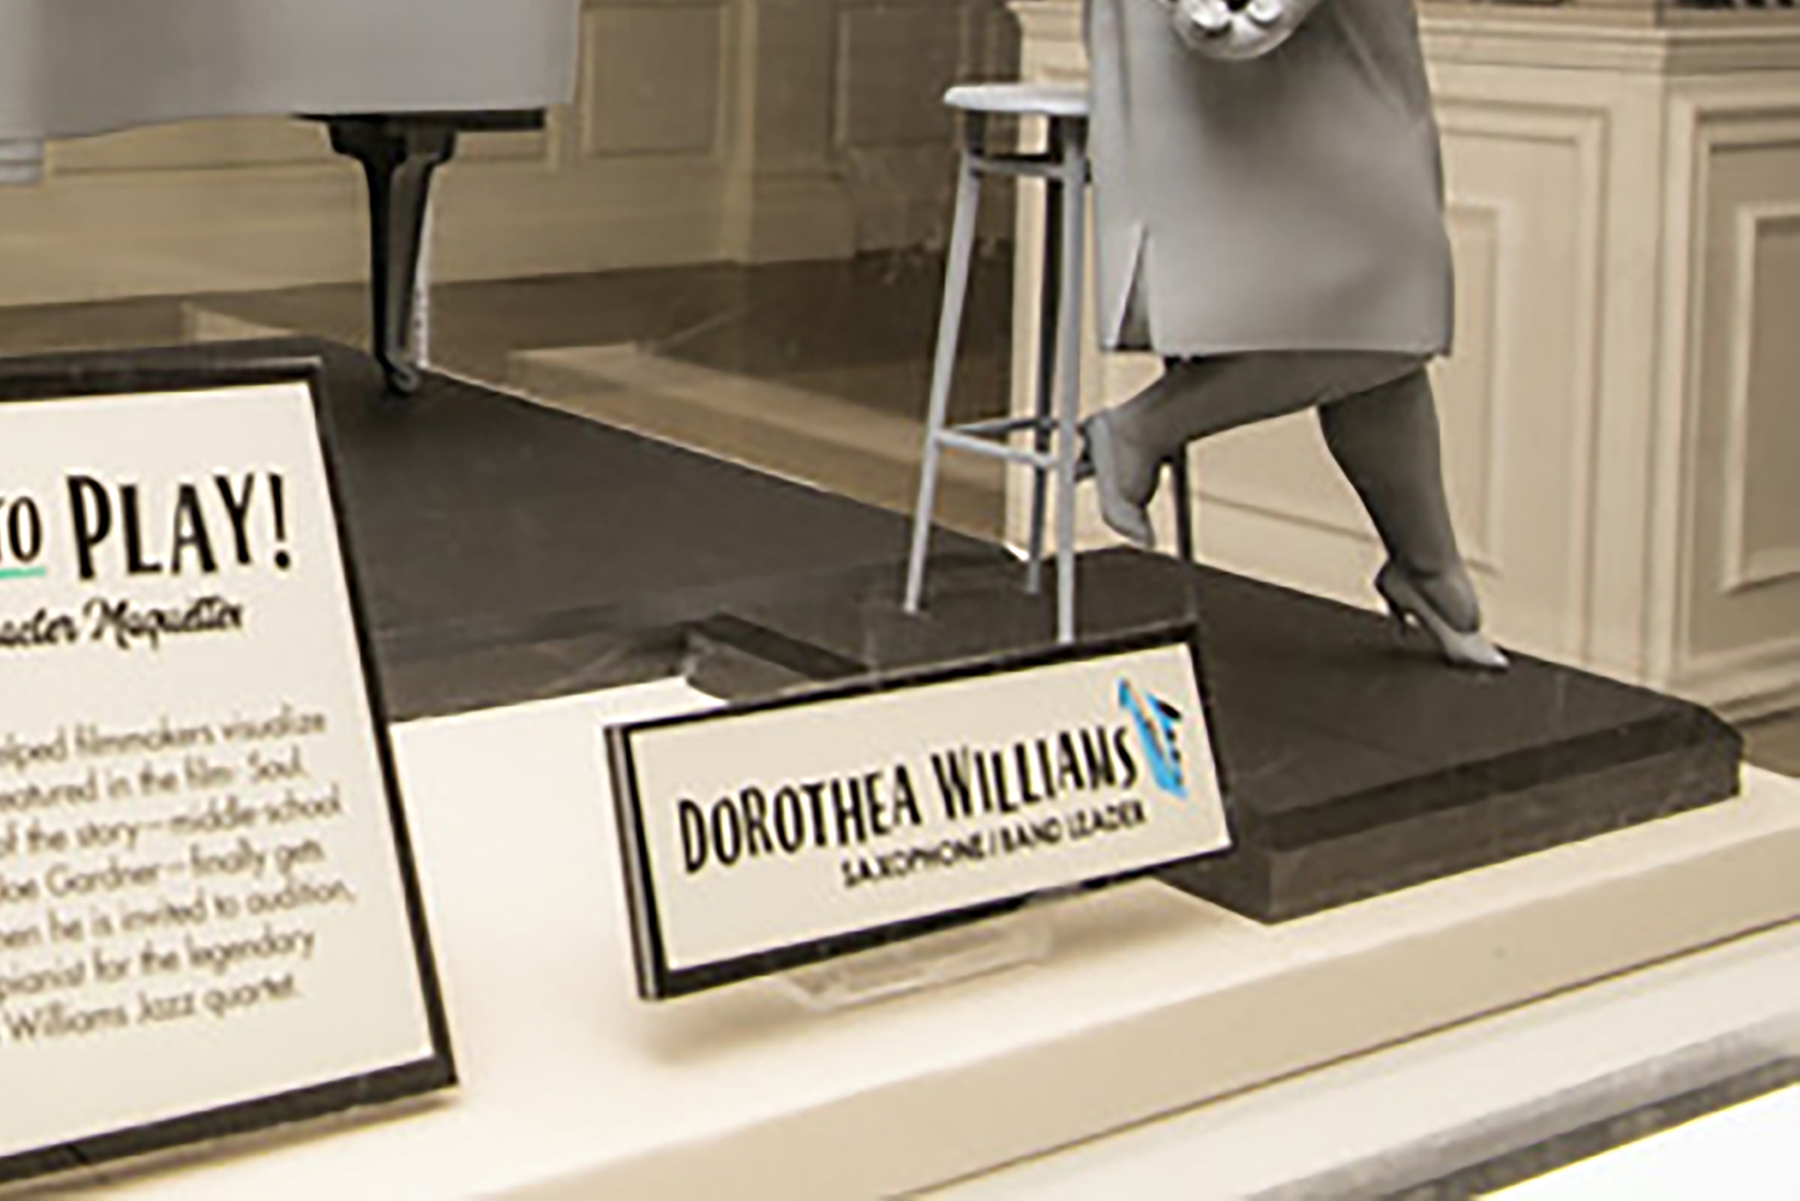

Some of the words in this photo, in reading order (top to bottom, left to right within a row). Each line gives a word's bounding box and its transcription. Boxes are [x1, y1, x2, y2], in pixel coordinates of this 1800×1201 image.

[66, 472, 292, 580] PLAY!
[74, 711, 215, 757] filmmakers
[221, 701, 327, 743] visualize
[105, 765, 132, 797] in
[139, 759, 179, 796] the
[678, 764, 921, 875] DOROTHEA
[931, 725, 1139, 822] WILLIAMS
[25, 817, 69, 854] the
[841, 833, 986, 887] SAXOPHONE
[999, 815, 1063, 853] BAND
[1067, 799, 1147, 841] LEADER
[47, 905, 83, 943] he
[89, 903, 115, 937] is
[120, 883, 208, 935] invited
[213, 893, 241, 921] to
[93, 943, 131, 973] for
[139, 937, 180, 976] the
[185, 917, 316, 979] legendary
[2, 991, 130, 1043] Williams
[136, 987, 196, 1025] Jazz
